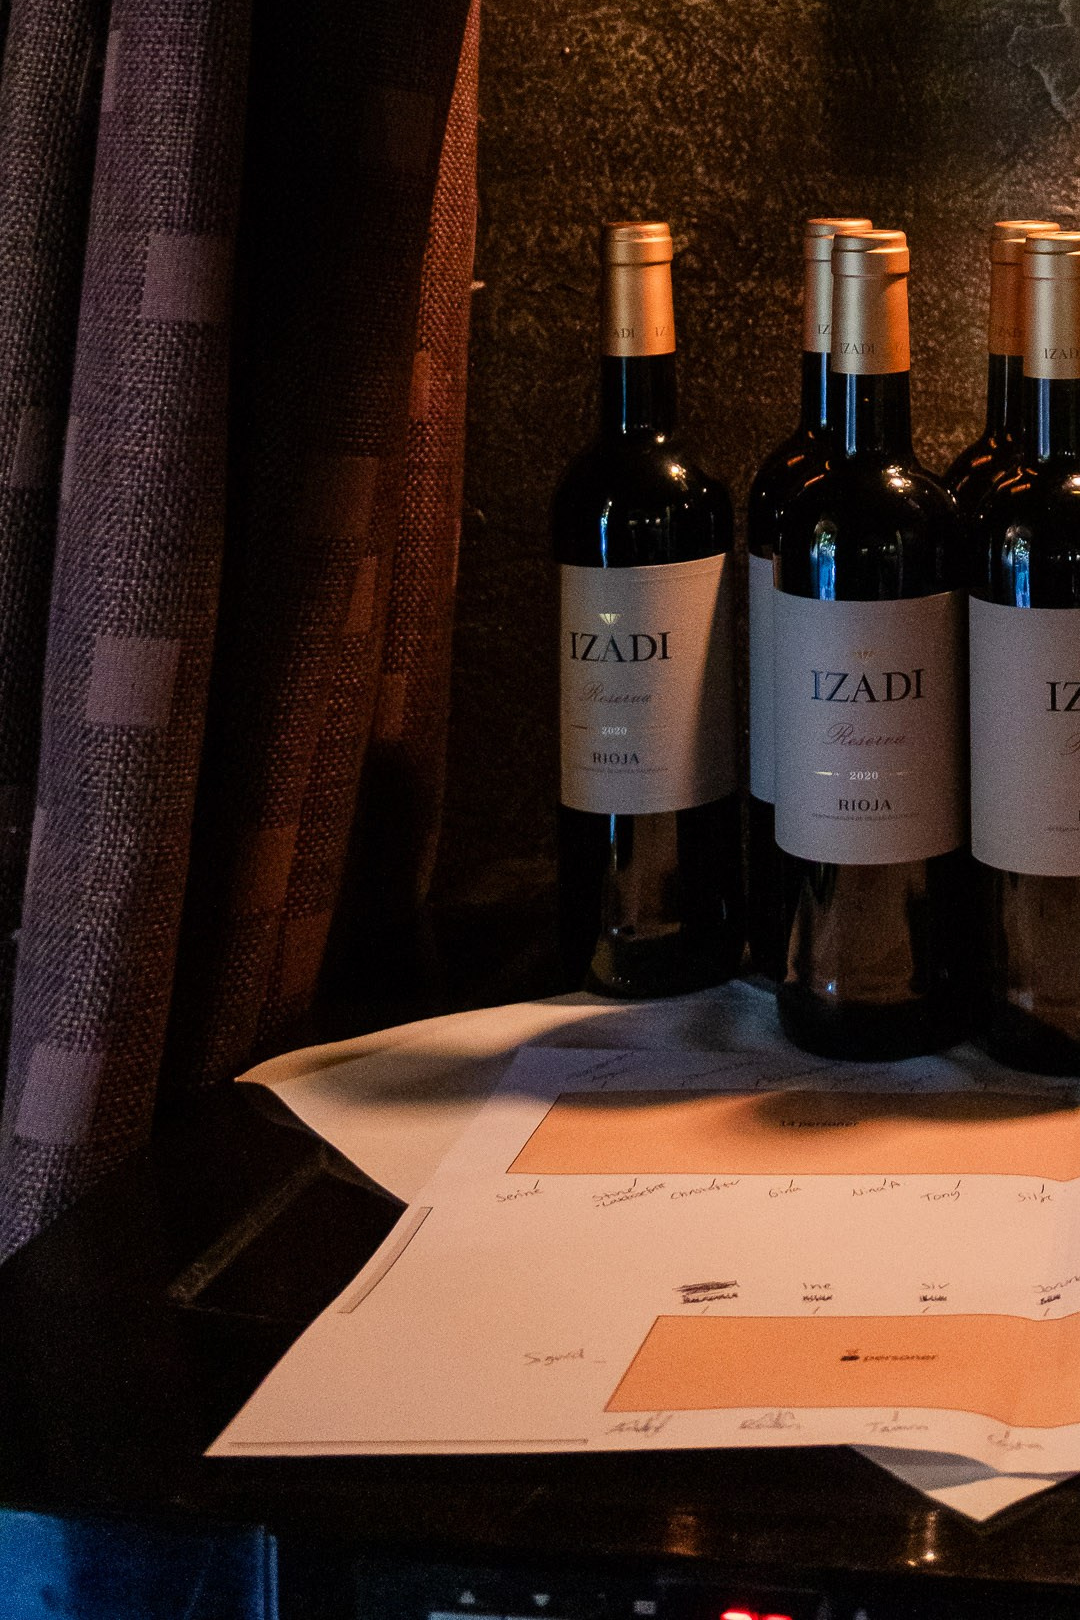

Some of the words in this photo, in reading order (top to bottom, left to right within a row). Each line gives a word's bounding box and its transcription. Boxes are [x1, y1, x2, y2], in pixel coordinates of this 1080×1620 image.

[840, 342, 875, 354] IZADI
[569, 631, 673, 663] IZADI
[811, 668, 926, 703] IZADI
[579, 682, 652, 704] Reserva
[602, 727, 628, 736] 2020
[822, 722, 906, 746] Reserva
[592, 752, 640, 765] RIOJA
[849, 771, 879, 781] 2020
[838, 798, 892, 812] RIOJA
[863, 1354, 938, 1363] personer
